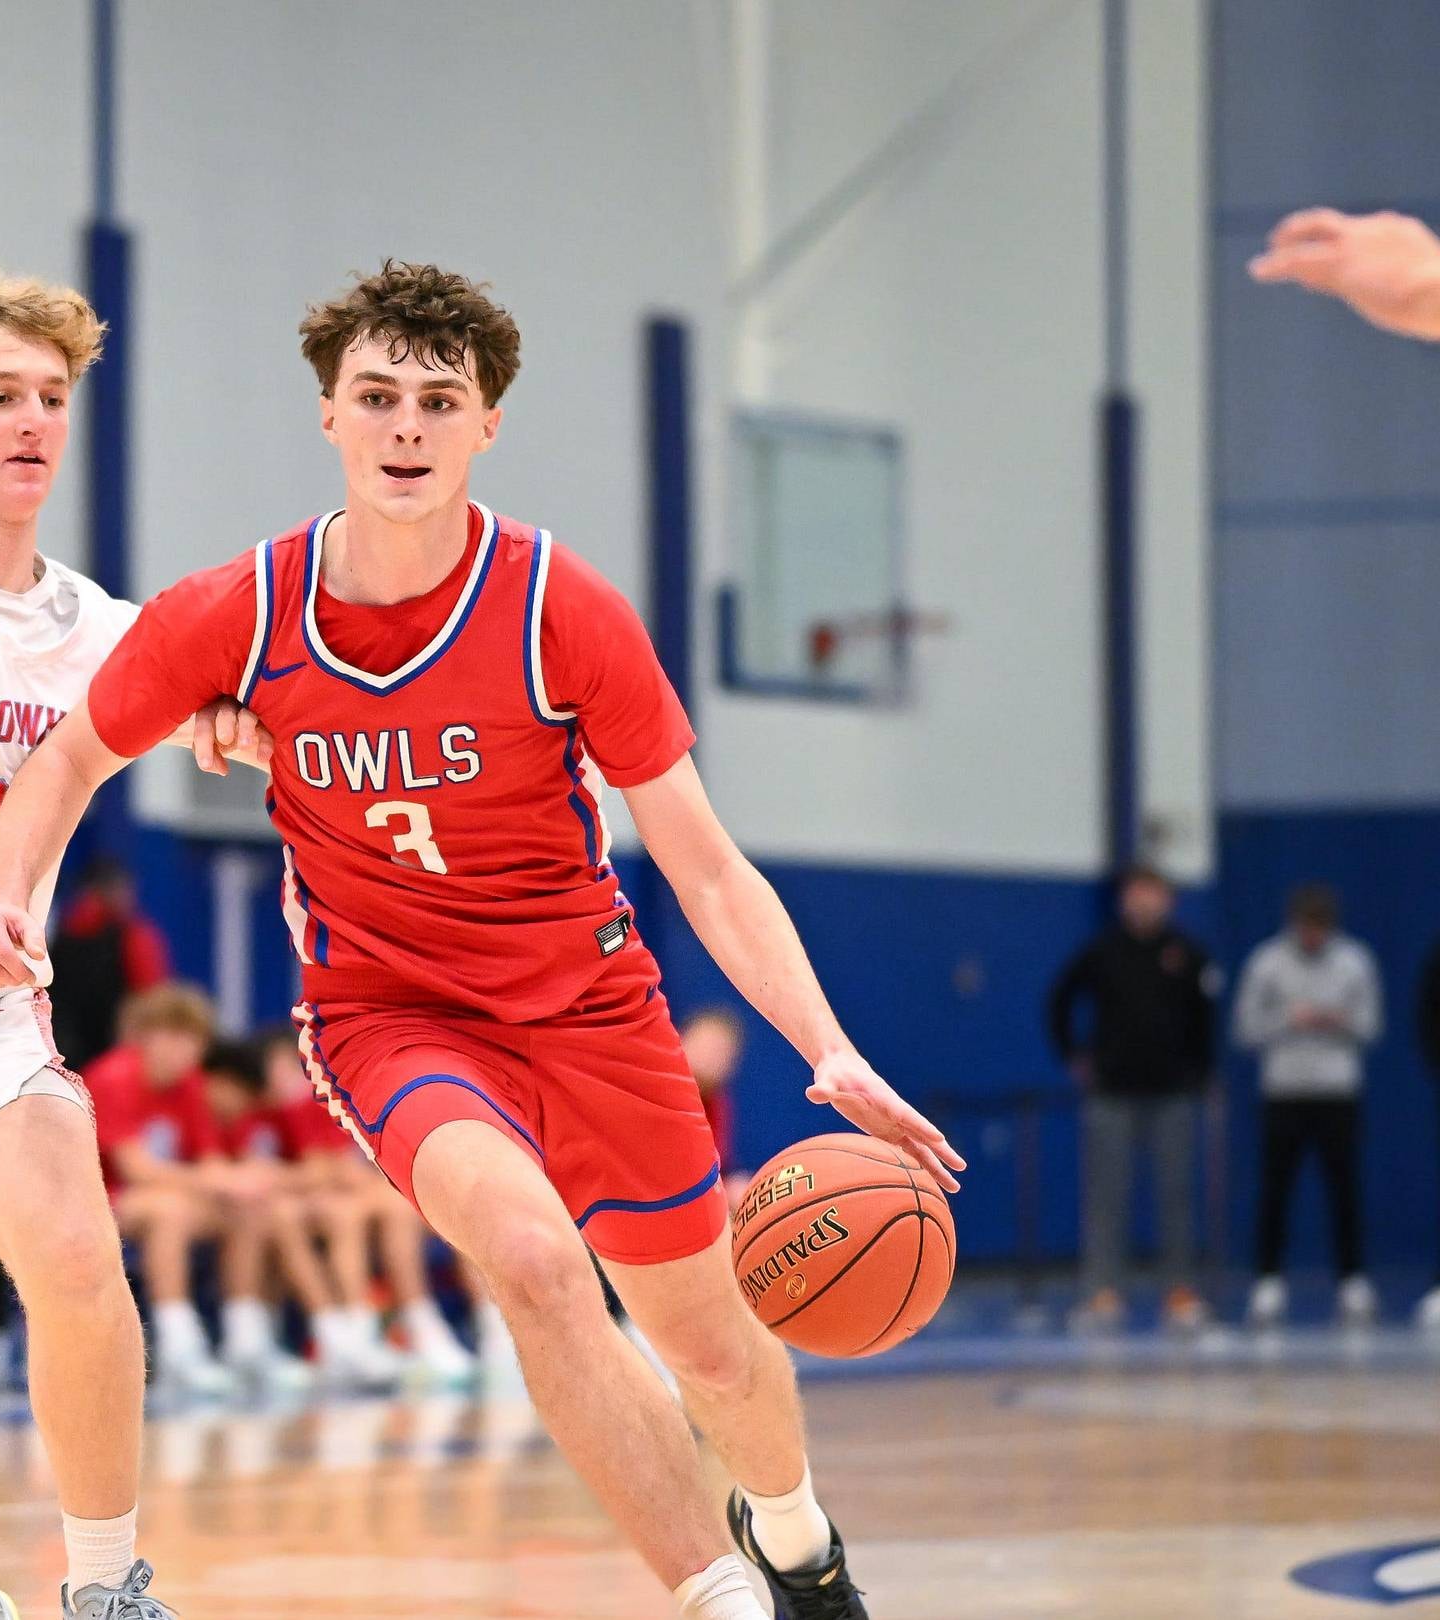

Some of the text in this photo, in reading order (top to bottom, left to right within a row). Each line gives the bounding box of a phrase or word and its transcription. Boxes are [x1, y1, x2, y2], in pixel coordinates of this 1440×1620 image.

[294, 723, 482, 793] OWLS
[364, 800, 447, 875] 3
[740, 1206, 849, 1309] SPALDING
